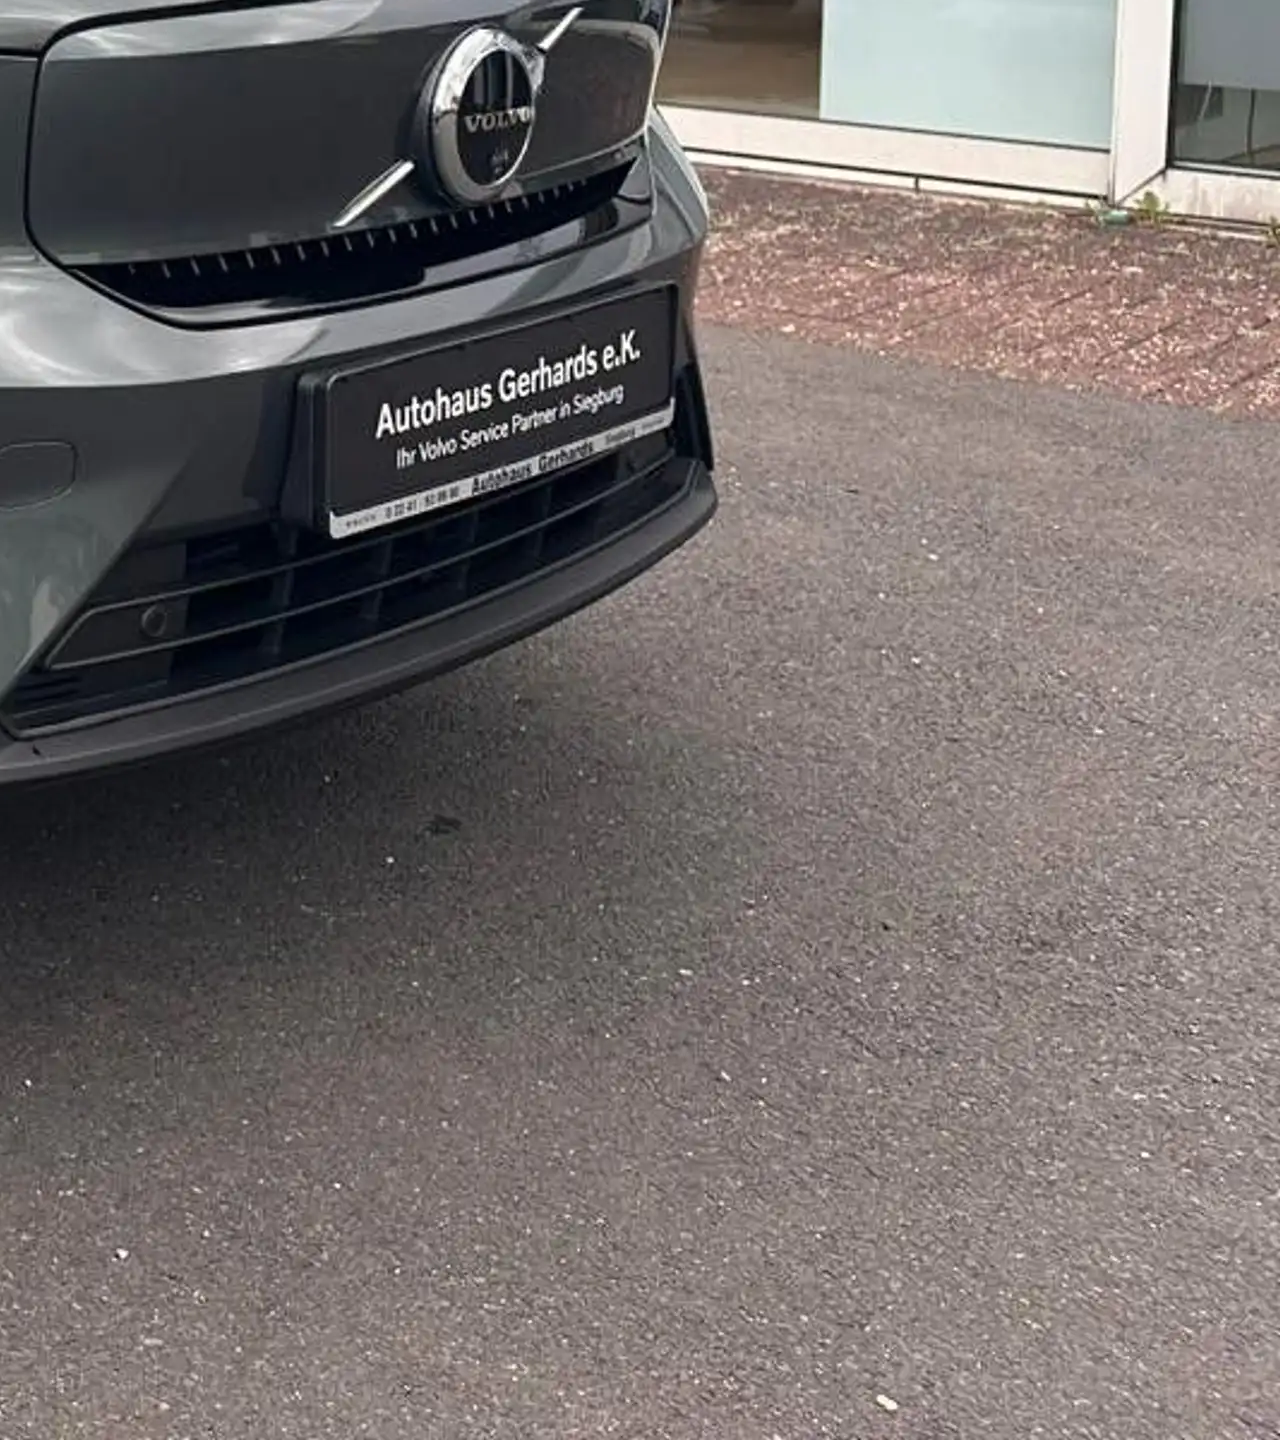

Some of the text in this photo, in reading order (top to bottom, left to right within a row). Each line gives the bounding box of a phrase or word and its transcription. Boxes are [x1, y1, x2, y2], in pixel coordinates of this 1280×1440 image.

[465, 106, 531, 132] VOLVO
[375, 328, 641, 440] Autohaus Gerhards e.K.
[396, 384, 624, 469] Ihr Volvo Service Partner in Siegburg
